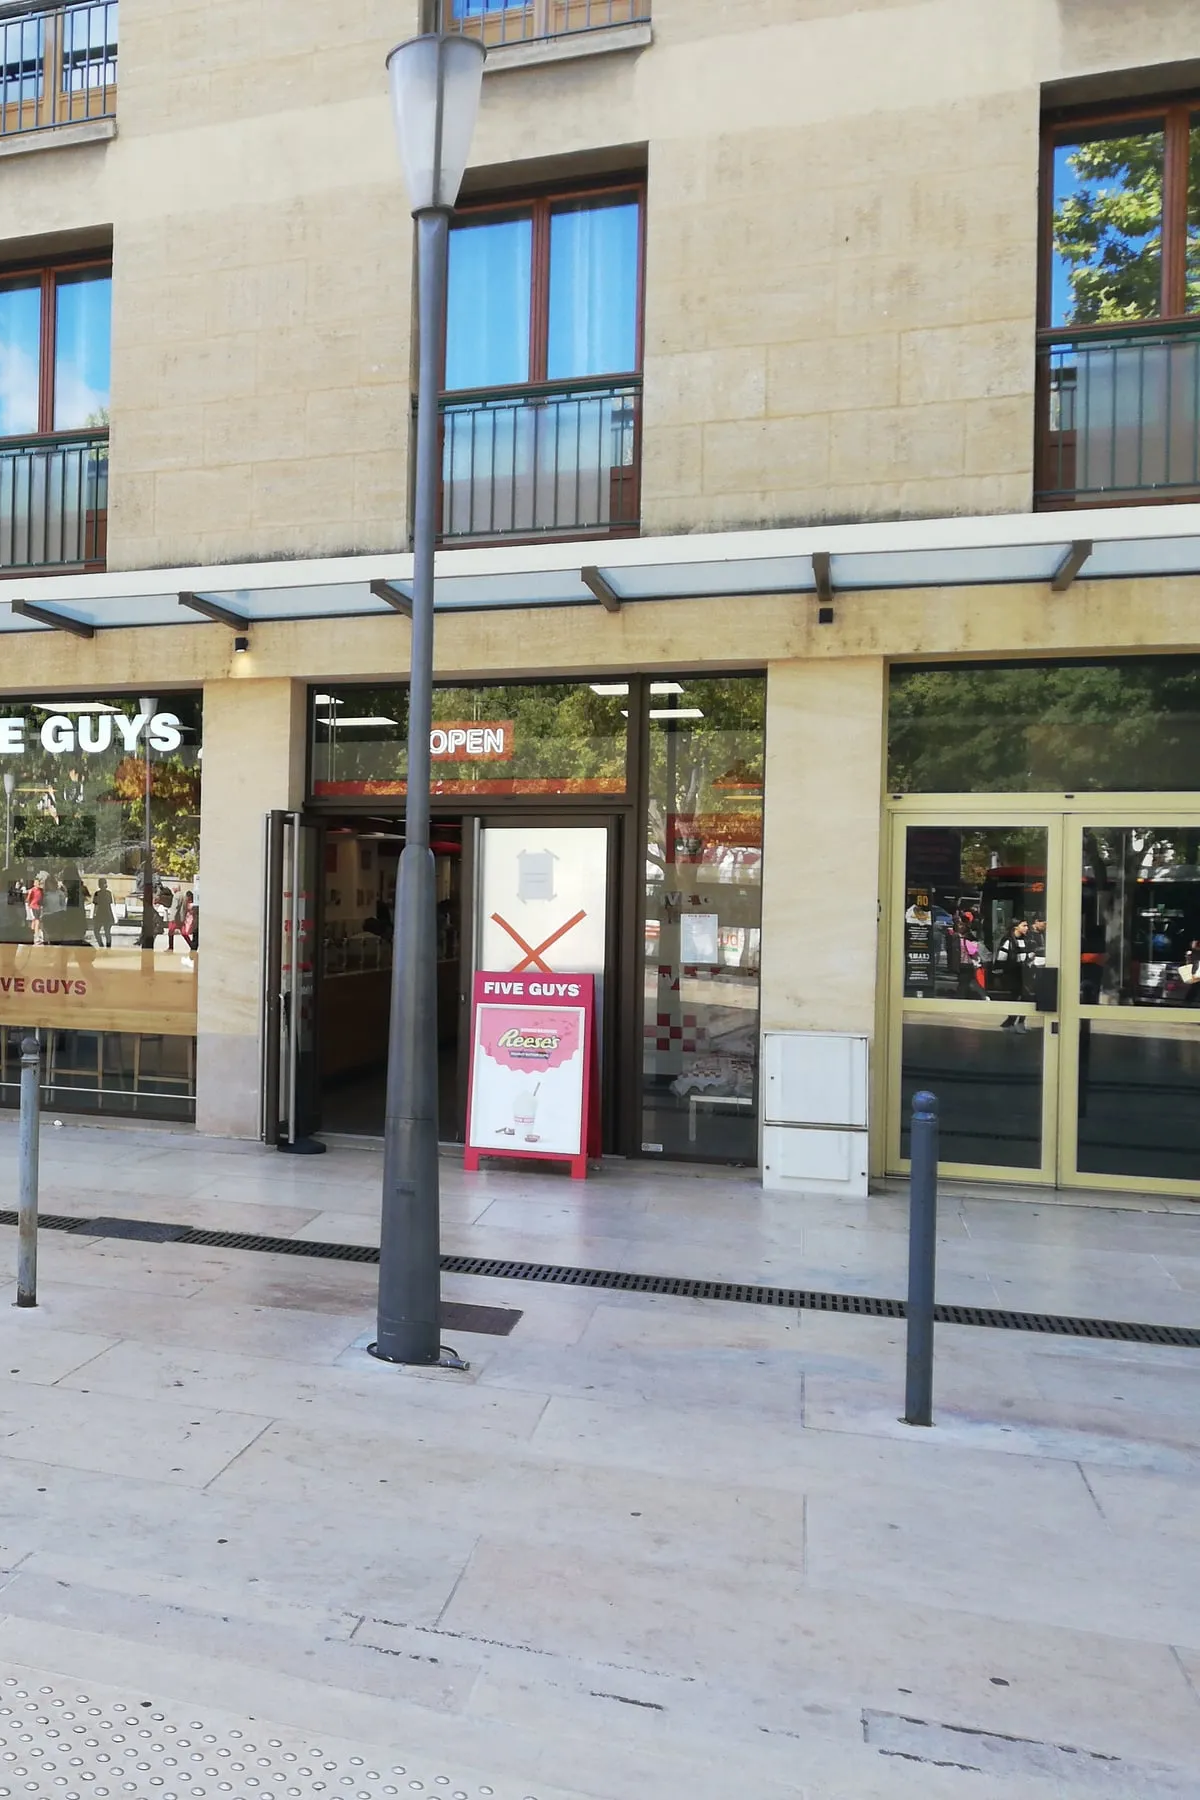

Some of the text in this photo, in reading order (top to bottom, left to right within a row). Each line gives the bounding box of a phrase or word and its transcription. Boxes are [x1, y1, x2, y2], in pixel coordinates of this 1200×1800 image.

[40, 712, 181, 754] GUYS
[429, 728, 504, 754] OPEN
[31, 978, 87, 995] GUYS
[484, 981, 581, 997] FIVE GUYS
[497, 1028, 561, 1049] Reese's
